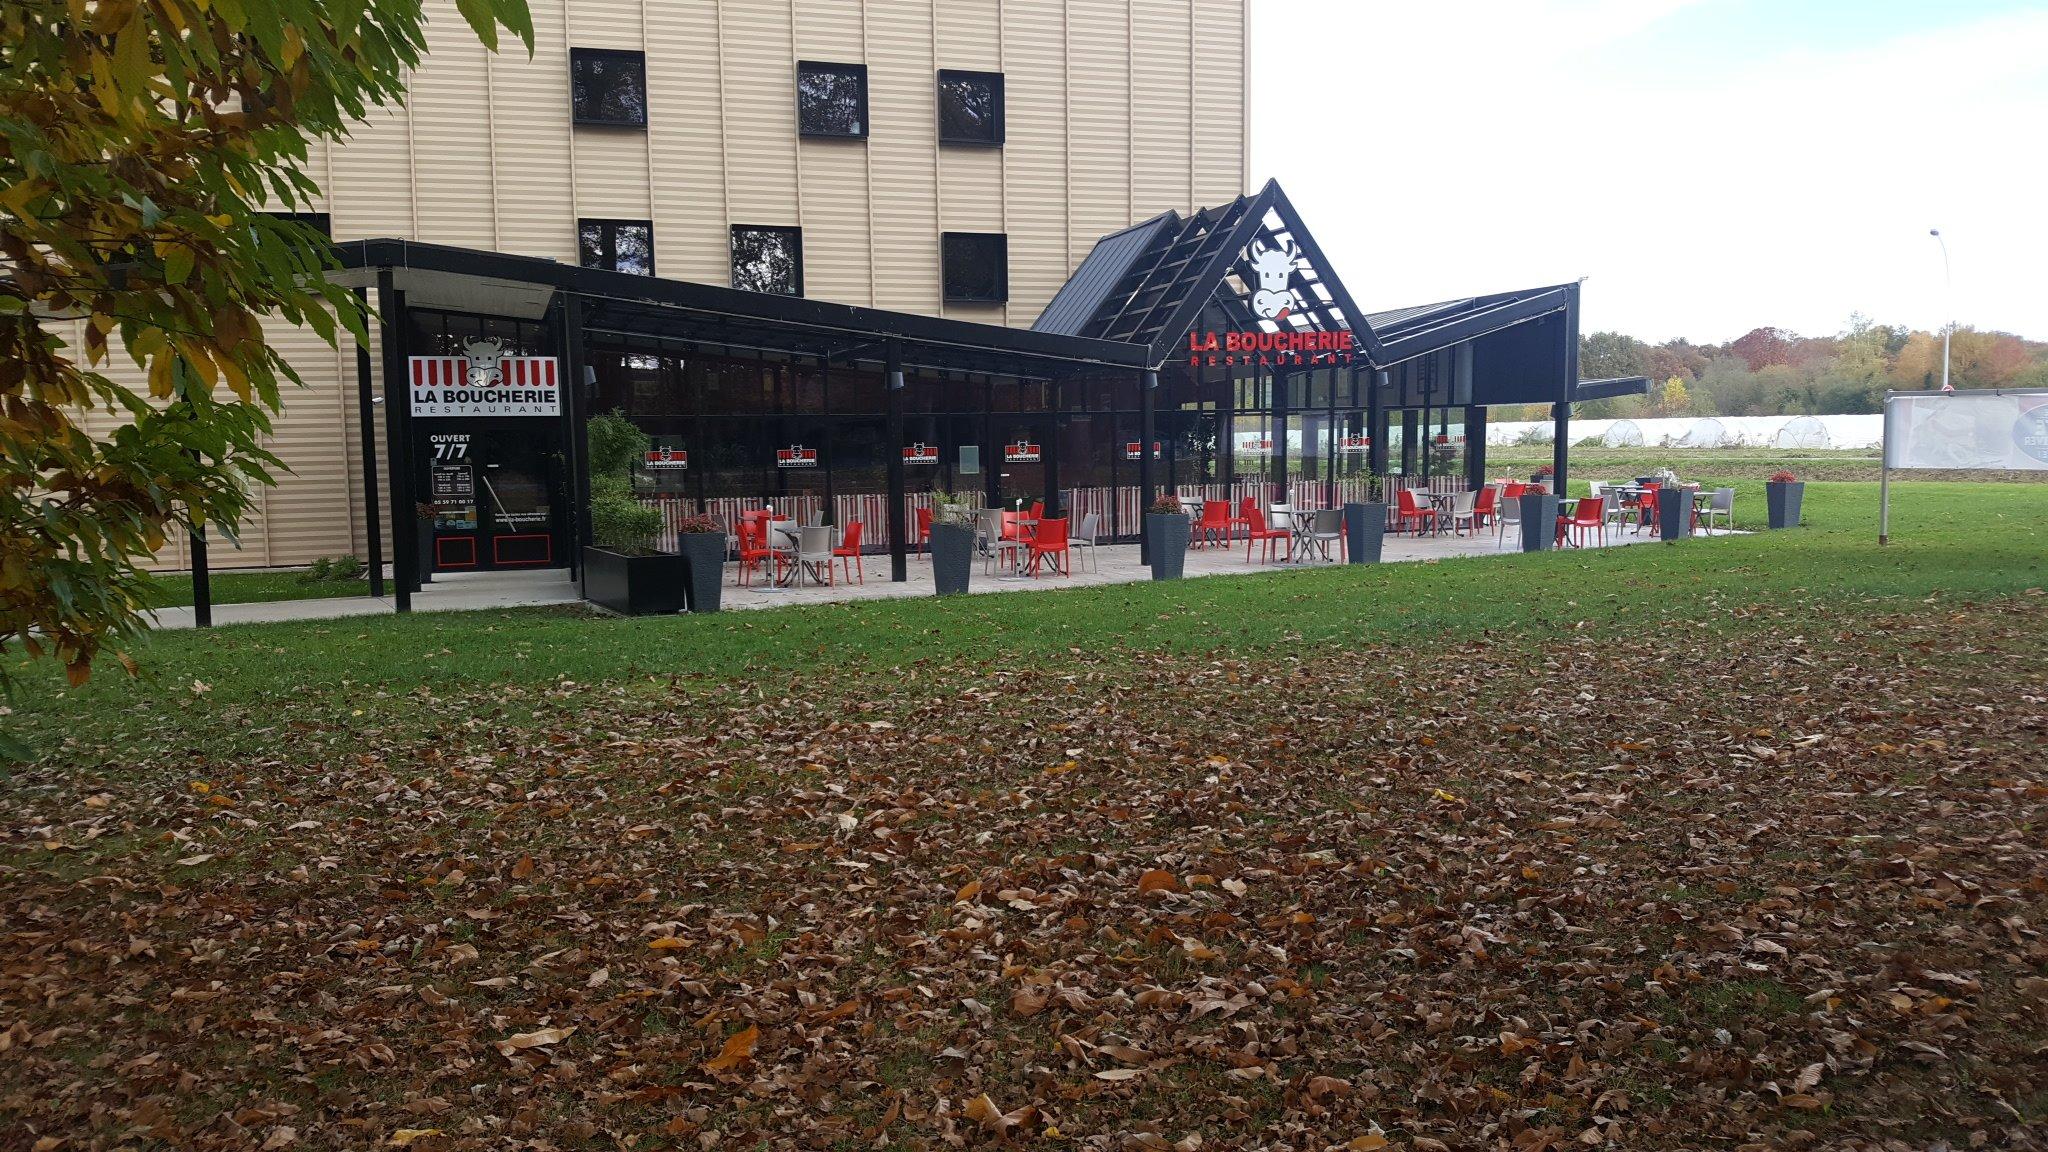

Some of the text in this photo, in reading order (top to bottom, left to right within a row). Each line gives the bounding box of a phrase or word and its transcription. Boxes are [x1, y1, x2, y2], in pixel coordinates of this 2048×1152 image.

[1189, 330, 1353, 352] LA BOUCHERIE
[1190, 354, 1353, 367] RESTAURANT
[414, 390, 556, 404] LA BOUCHERIE
[414, 405, 556, 414] RESTAURANT
[430, 434, 471, 443] OUVERT
[434, 443, 467, 460] 7/7
